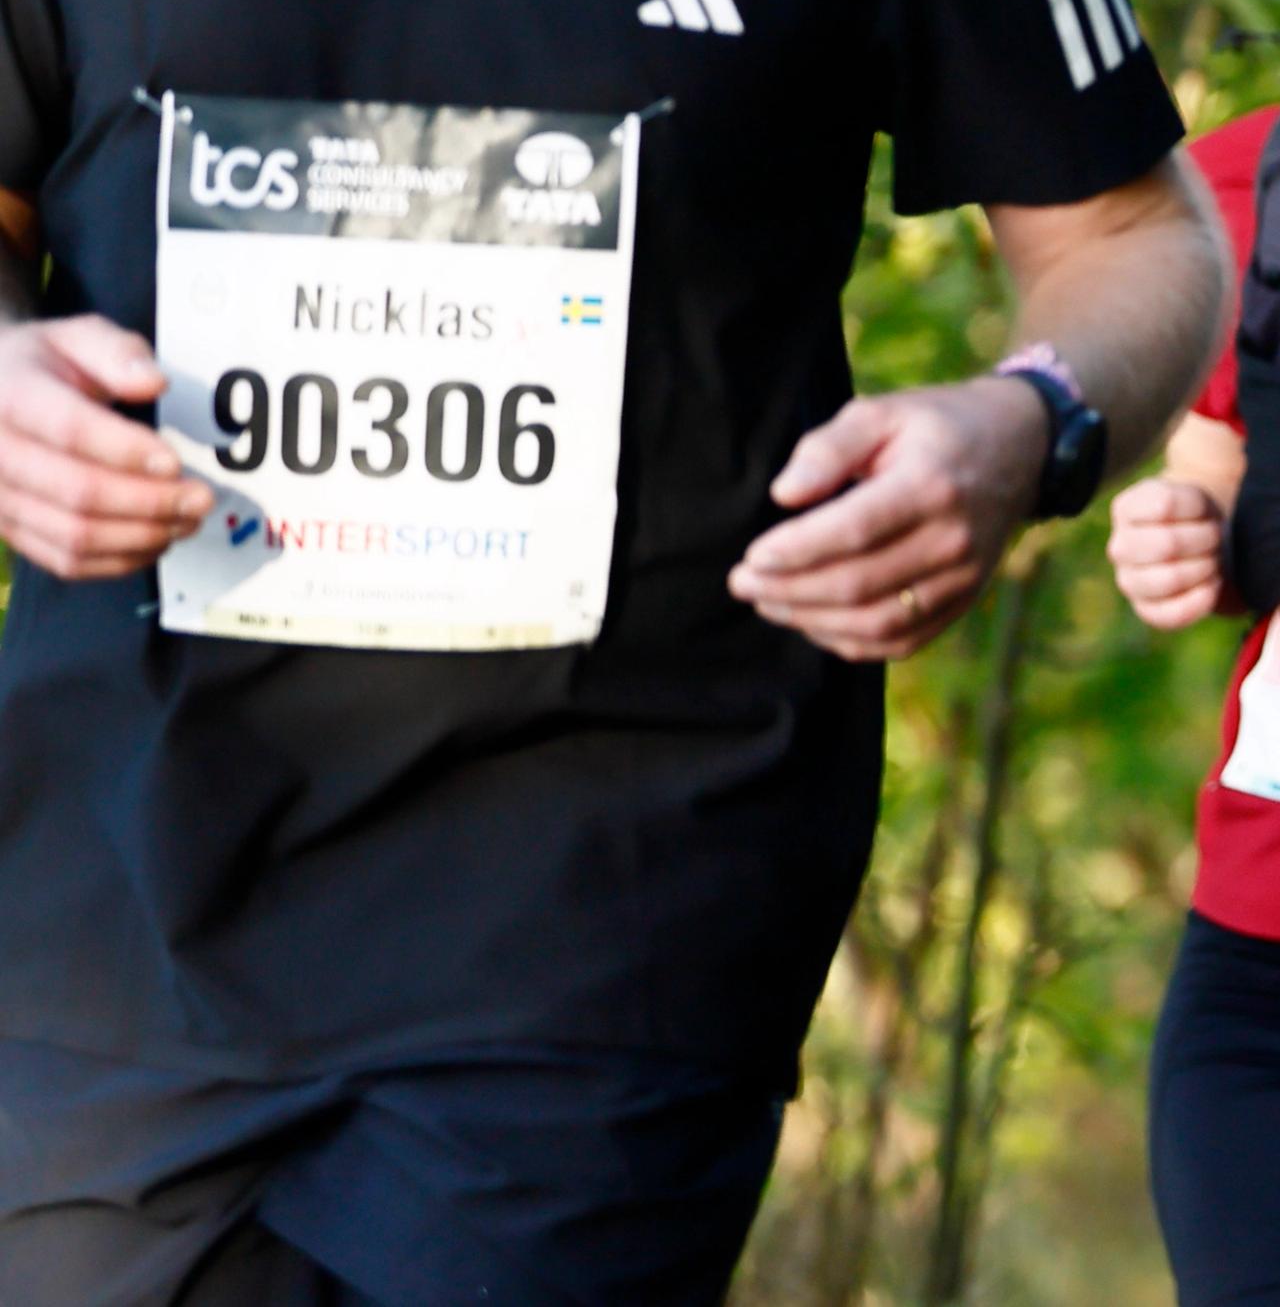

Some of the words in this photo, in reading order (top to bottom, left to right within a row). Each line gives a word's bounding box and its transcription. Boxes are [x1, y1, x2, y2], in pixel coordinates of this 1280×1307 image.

[190, 130, 299, 211] tcs
[293, 283, 495, 340] Nicklas
[213, 367, 557, 487] 90306
[265, 518, 535, 560] INTERSPORT
